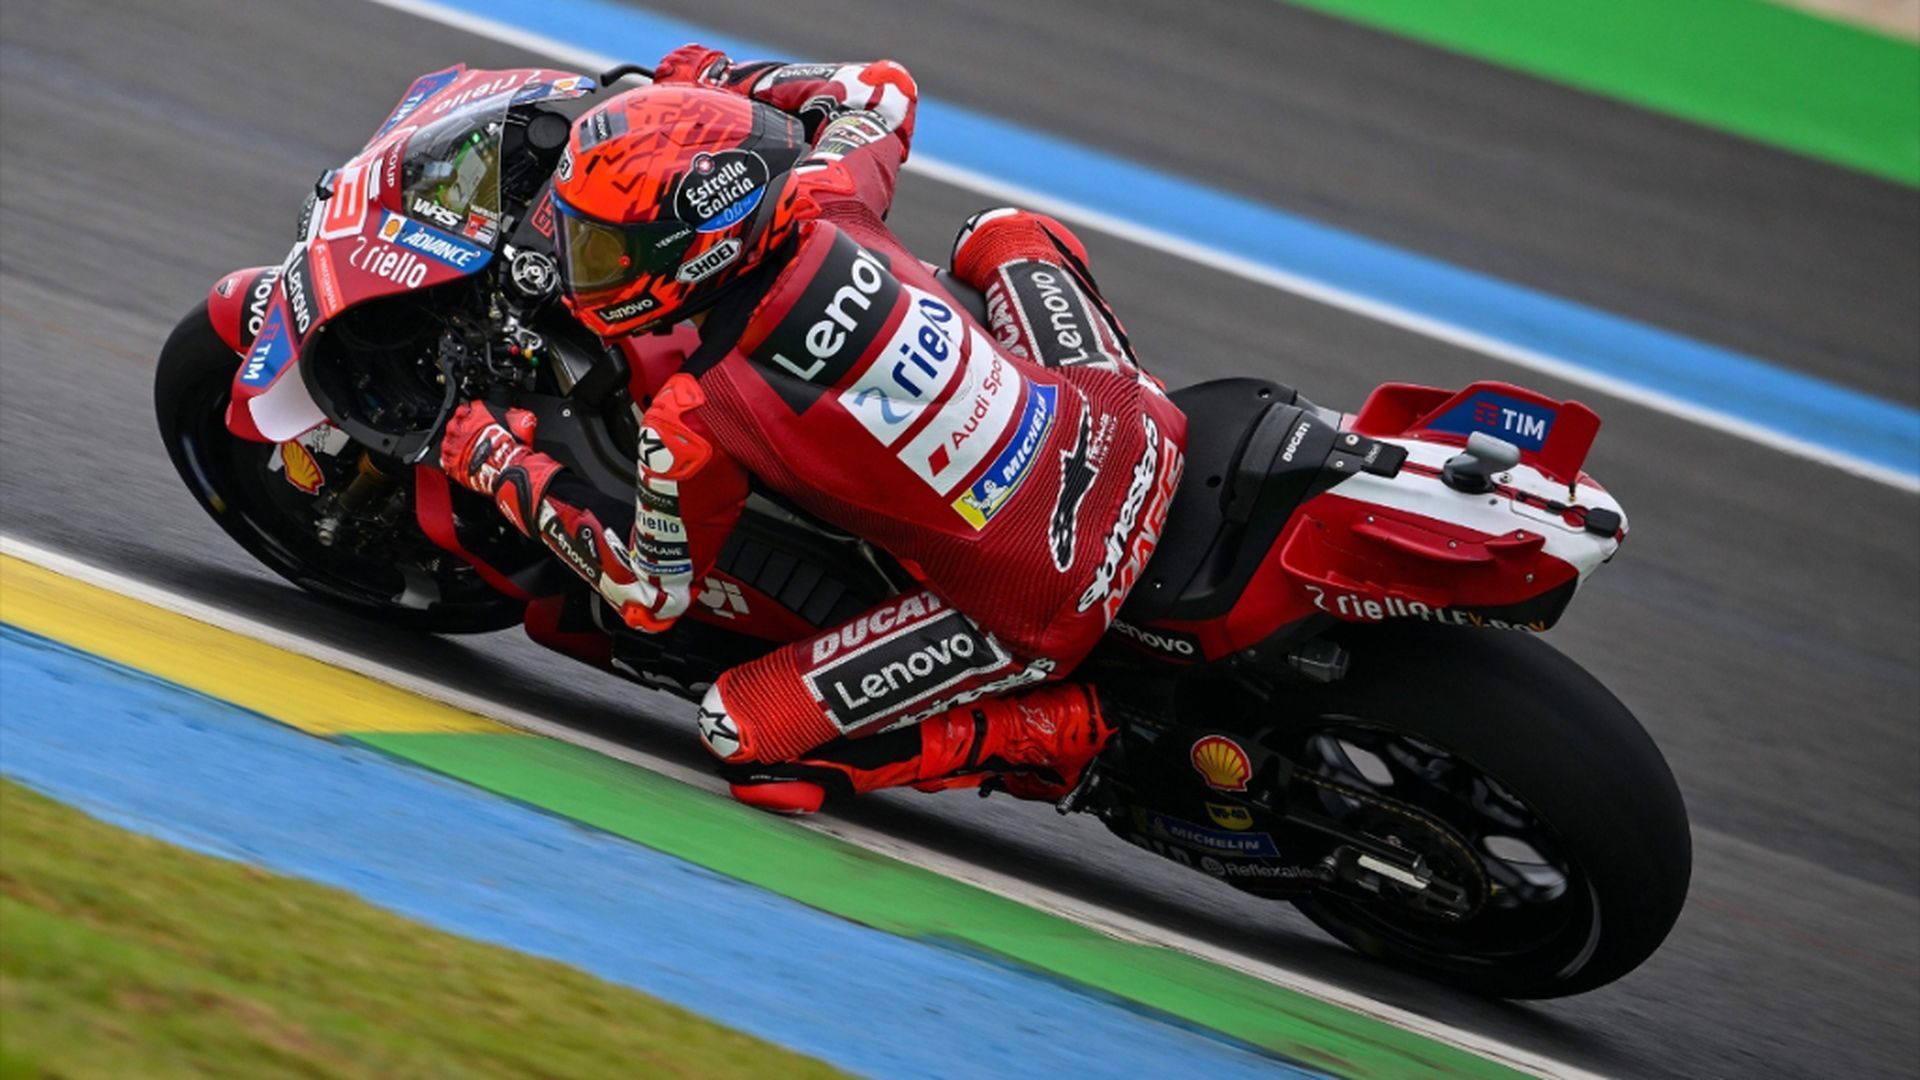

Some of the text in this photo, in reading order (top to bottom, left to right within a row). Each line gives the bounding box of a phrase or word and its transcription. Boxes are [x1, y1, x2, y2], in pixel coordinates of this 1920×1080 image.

[432, 74, 517, 115] riello
[686, 161, 748, 208] Estrella
[697, 178, 755, 219] Galicia
[413, 197, 463, 227] WRS
[361, 245, 428, 289] riello
[403, 232, 474, 266] ADVANCE
[685, 244, 735, 279] SHOEI
[288, 256, 310, 335] Lenovo
[600, 299, 654, 330] Lenovo
[1030, 271, 1089, 366] Lenovo
[243, 343, 272, 380] TIM
[951, 353, 1003, 450] Audi Spo
[1282, 421, 1312, 462] DUCATI
[1502, 407, 1546, 441] TIM
[550, 523, 596, 579] Lenovo
[812, 591, 942, 665] DUCAT
[1110, 618, 1194, 655] enovo
[834, 632, 975, 710] Lenovo
[1171, 826, 1260, 850] MICHELIN
